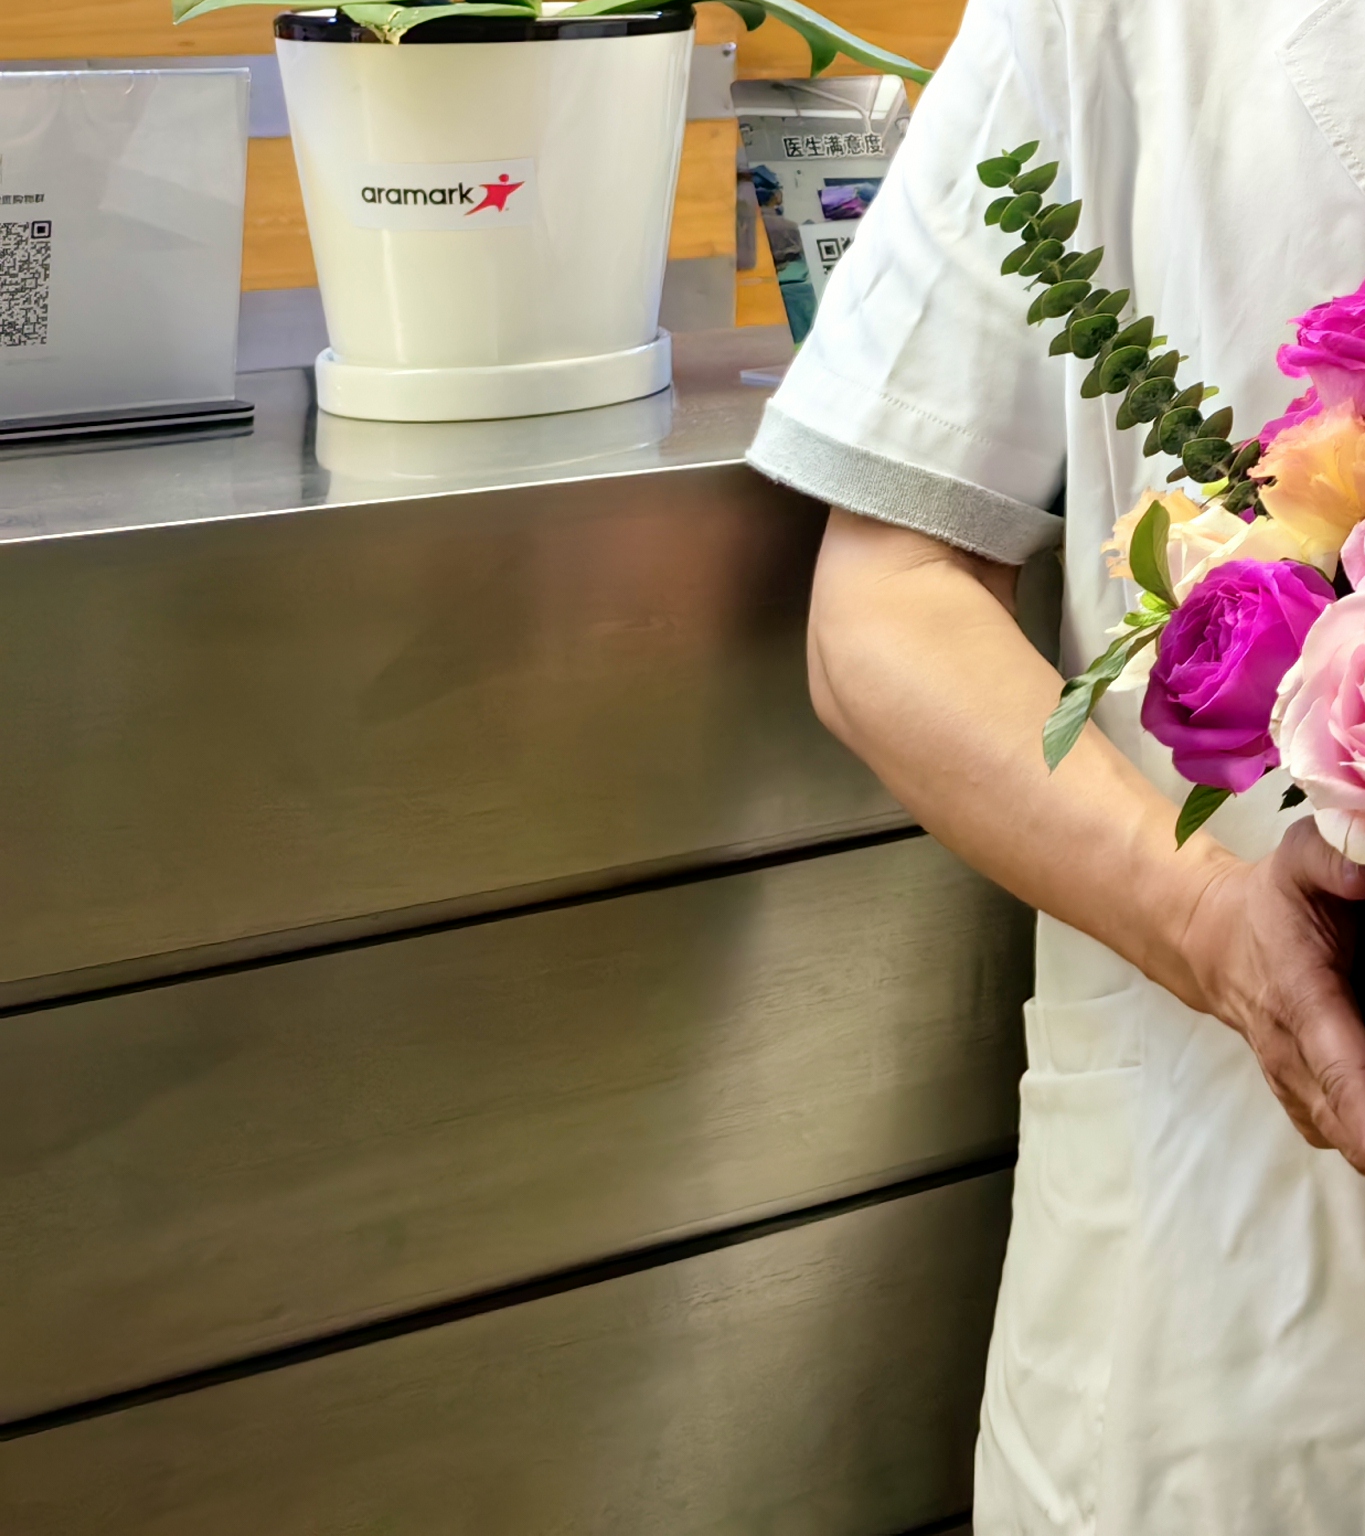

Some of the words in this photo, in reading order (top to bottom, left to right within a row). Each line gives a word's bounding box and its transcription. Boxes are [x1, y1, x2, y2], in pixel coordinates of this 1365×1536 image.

[784, 134, 884, 157] 医生满意度
[361, 182, 474, 205] aramark
